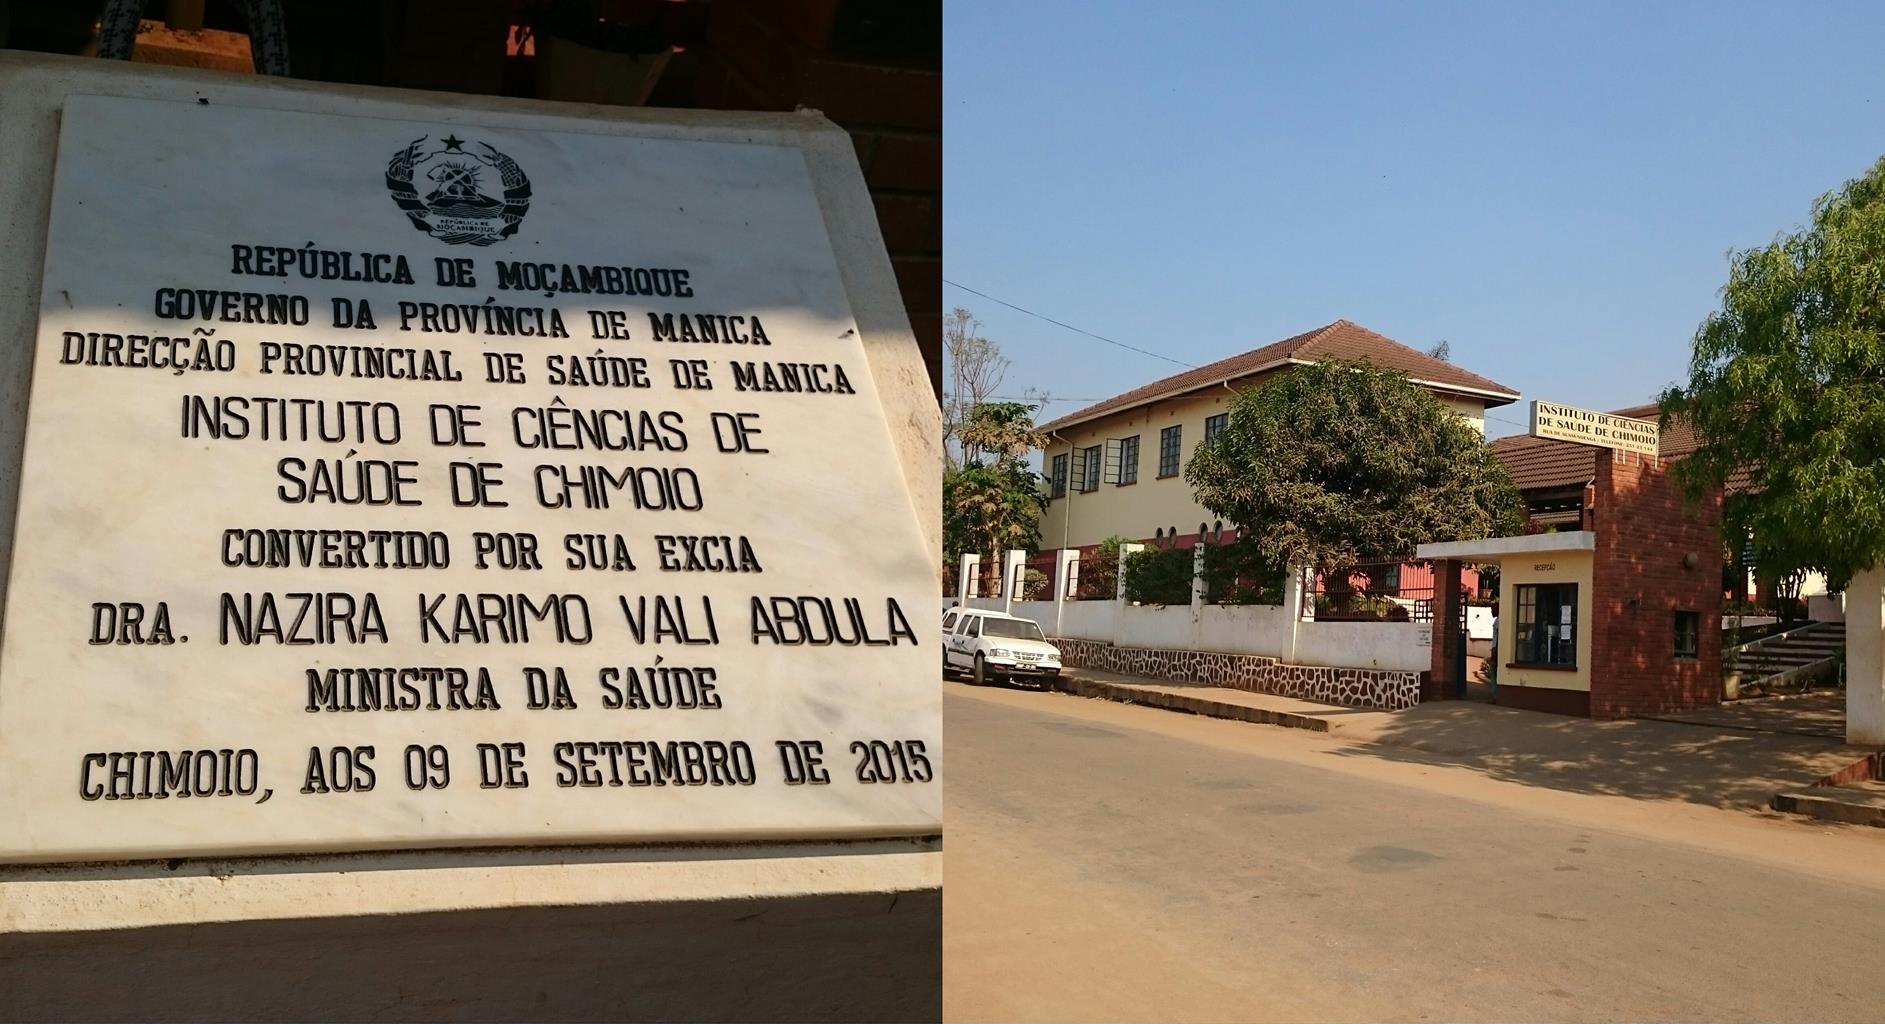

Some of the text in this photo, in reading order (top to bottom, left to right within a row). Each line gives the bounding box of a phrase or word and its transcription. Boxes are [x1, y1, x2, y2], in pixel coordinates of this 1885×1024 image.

[231, 242, 694, 299] REPÚBLICA DE MOÇAMBIQUE
[154, 287, 772, 347] GOVERNO DA PROVÍNCIA DE MANICA
[59, 328, 857, 396] DIRECÇÃO PROVINCIAL DE SAÚDE DE MANICA
[180, 395, 770, 455] INSTITUTO DE CIÊNCIAS DE
[1538, 416, 1554, 427] DE
[1594, 426, 1609, 437] DE
[1611, 430, 1656, 445] CHIMOIO
[1539, 404, 1595, 423] INSTITUTO
[1598, 415, 1611, 426] DE
[276, 448, 703, 512] SAÚDE DE CHIMOIO
[221, 528, 763, 574] CONVERTIDO POR SUA EXCIA
[88, 591, 919, 647] DRA. NAZIRA KARIMO VALI ABDULA
[305, 653, 722, 713] MINISTRA DA SAÚDE
[79, 738, 934, 804] CHIMOIO, AOS 09 DE SETEMBRO DE 2015
